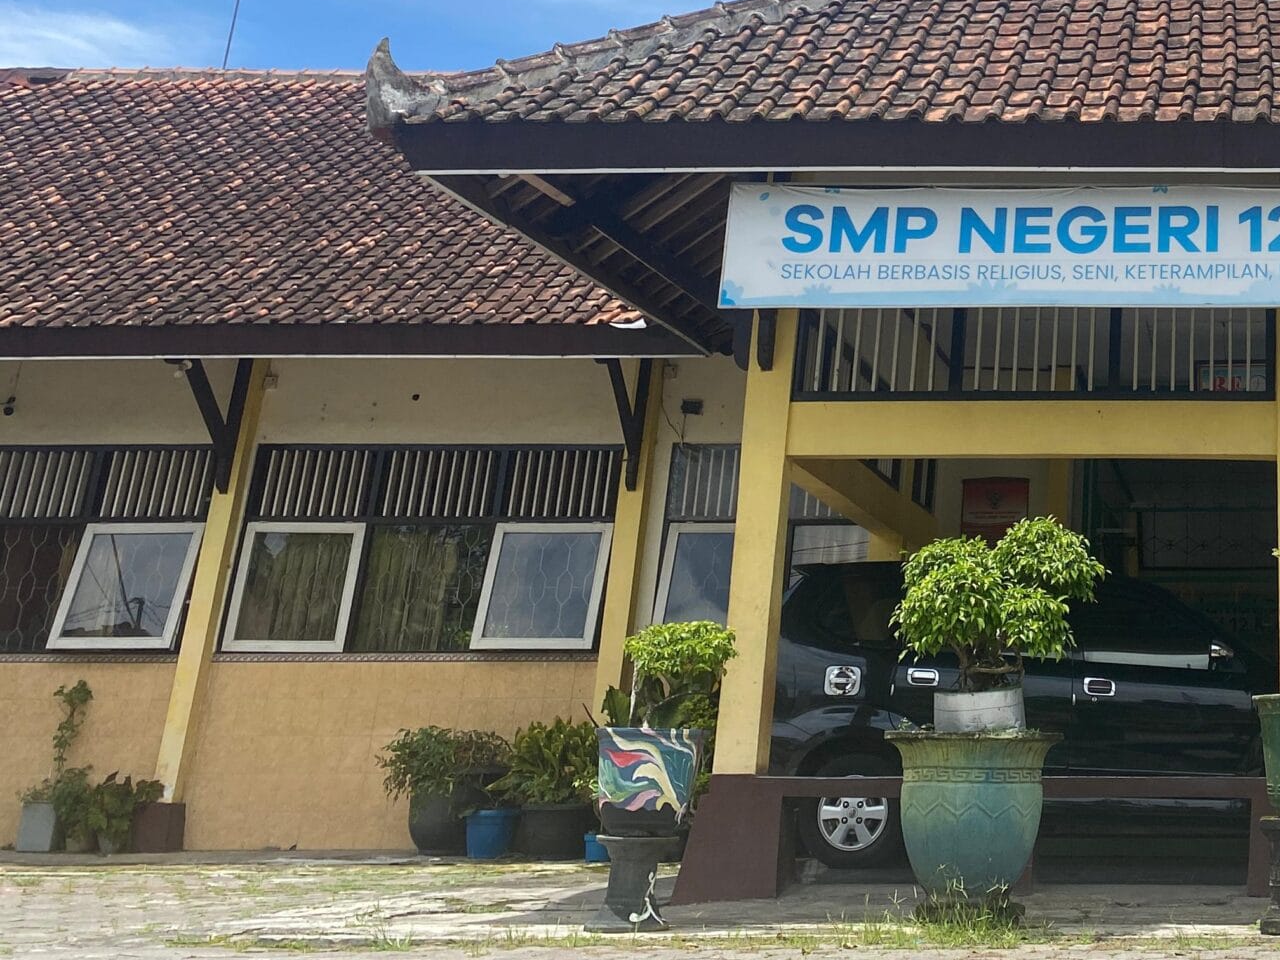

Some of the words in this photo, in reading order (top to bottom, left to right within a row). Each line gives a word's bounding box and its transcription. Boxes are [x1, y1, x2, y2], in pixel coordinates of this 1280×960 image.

[782, 204, 938, 254] SMP
[958, 205, 1219, 254] NEGERI
[781, 264, 871, 280] SEKOLAH
[877, 264, 970, 280] BERBASIS
[977, 264, 1066, 282] RELIGIUS,
[1072, 264, 1118, 282] SENI,
[1125, 263, 1273, 280] KETERAMPILAN,
